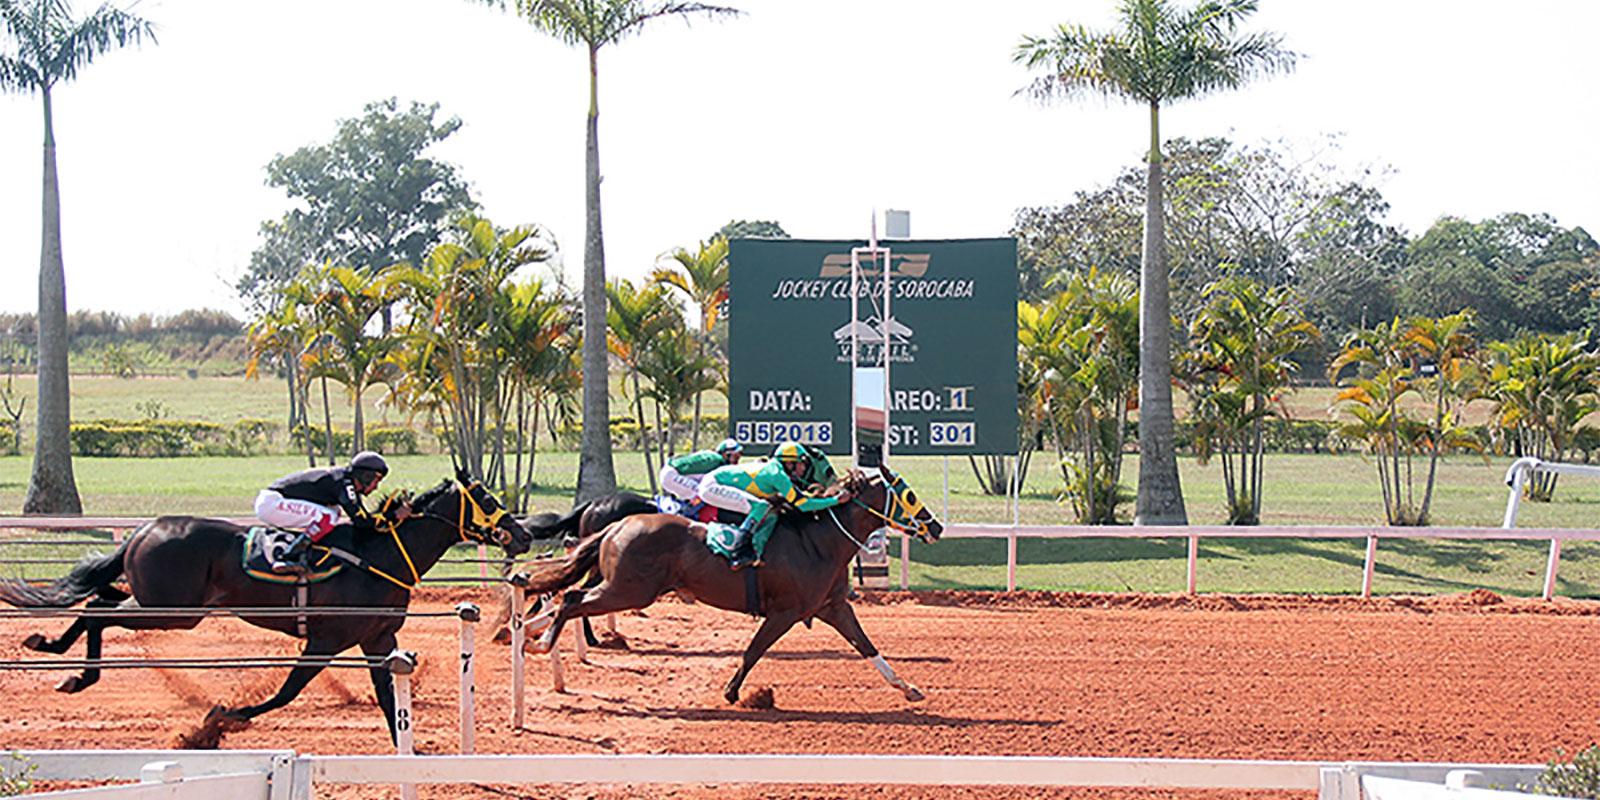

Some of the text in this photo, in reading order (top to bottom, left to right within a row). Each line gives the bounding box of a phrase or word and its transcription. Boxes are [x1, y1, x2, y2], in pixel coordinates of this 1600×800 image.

[772, 279, 832, 298] JOCKEY
[895, 279, 975, 298] SOROCABA
[840, 344, 909, 356] VETIL
[749, 390, 812, 411] DATA:
[931, 425, 972, 443] 301
[461, 652, 473, 674] 7
